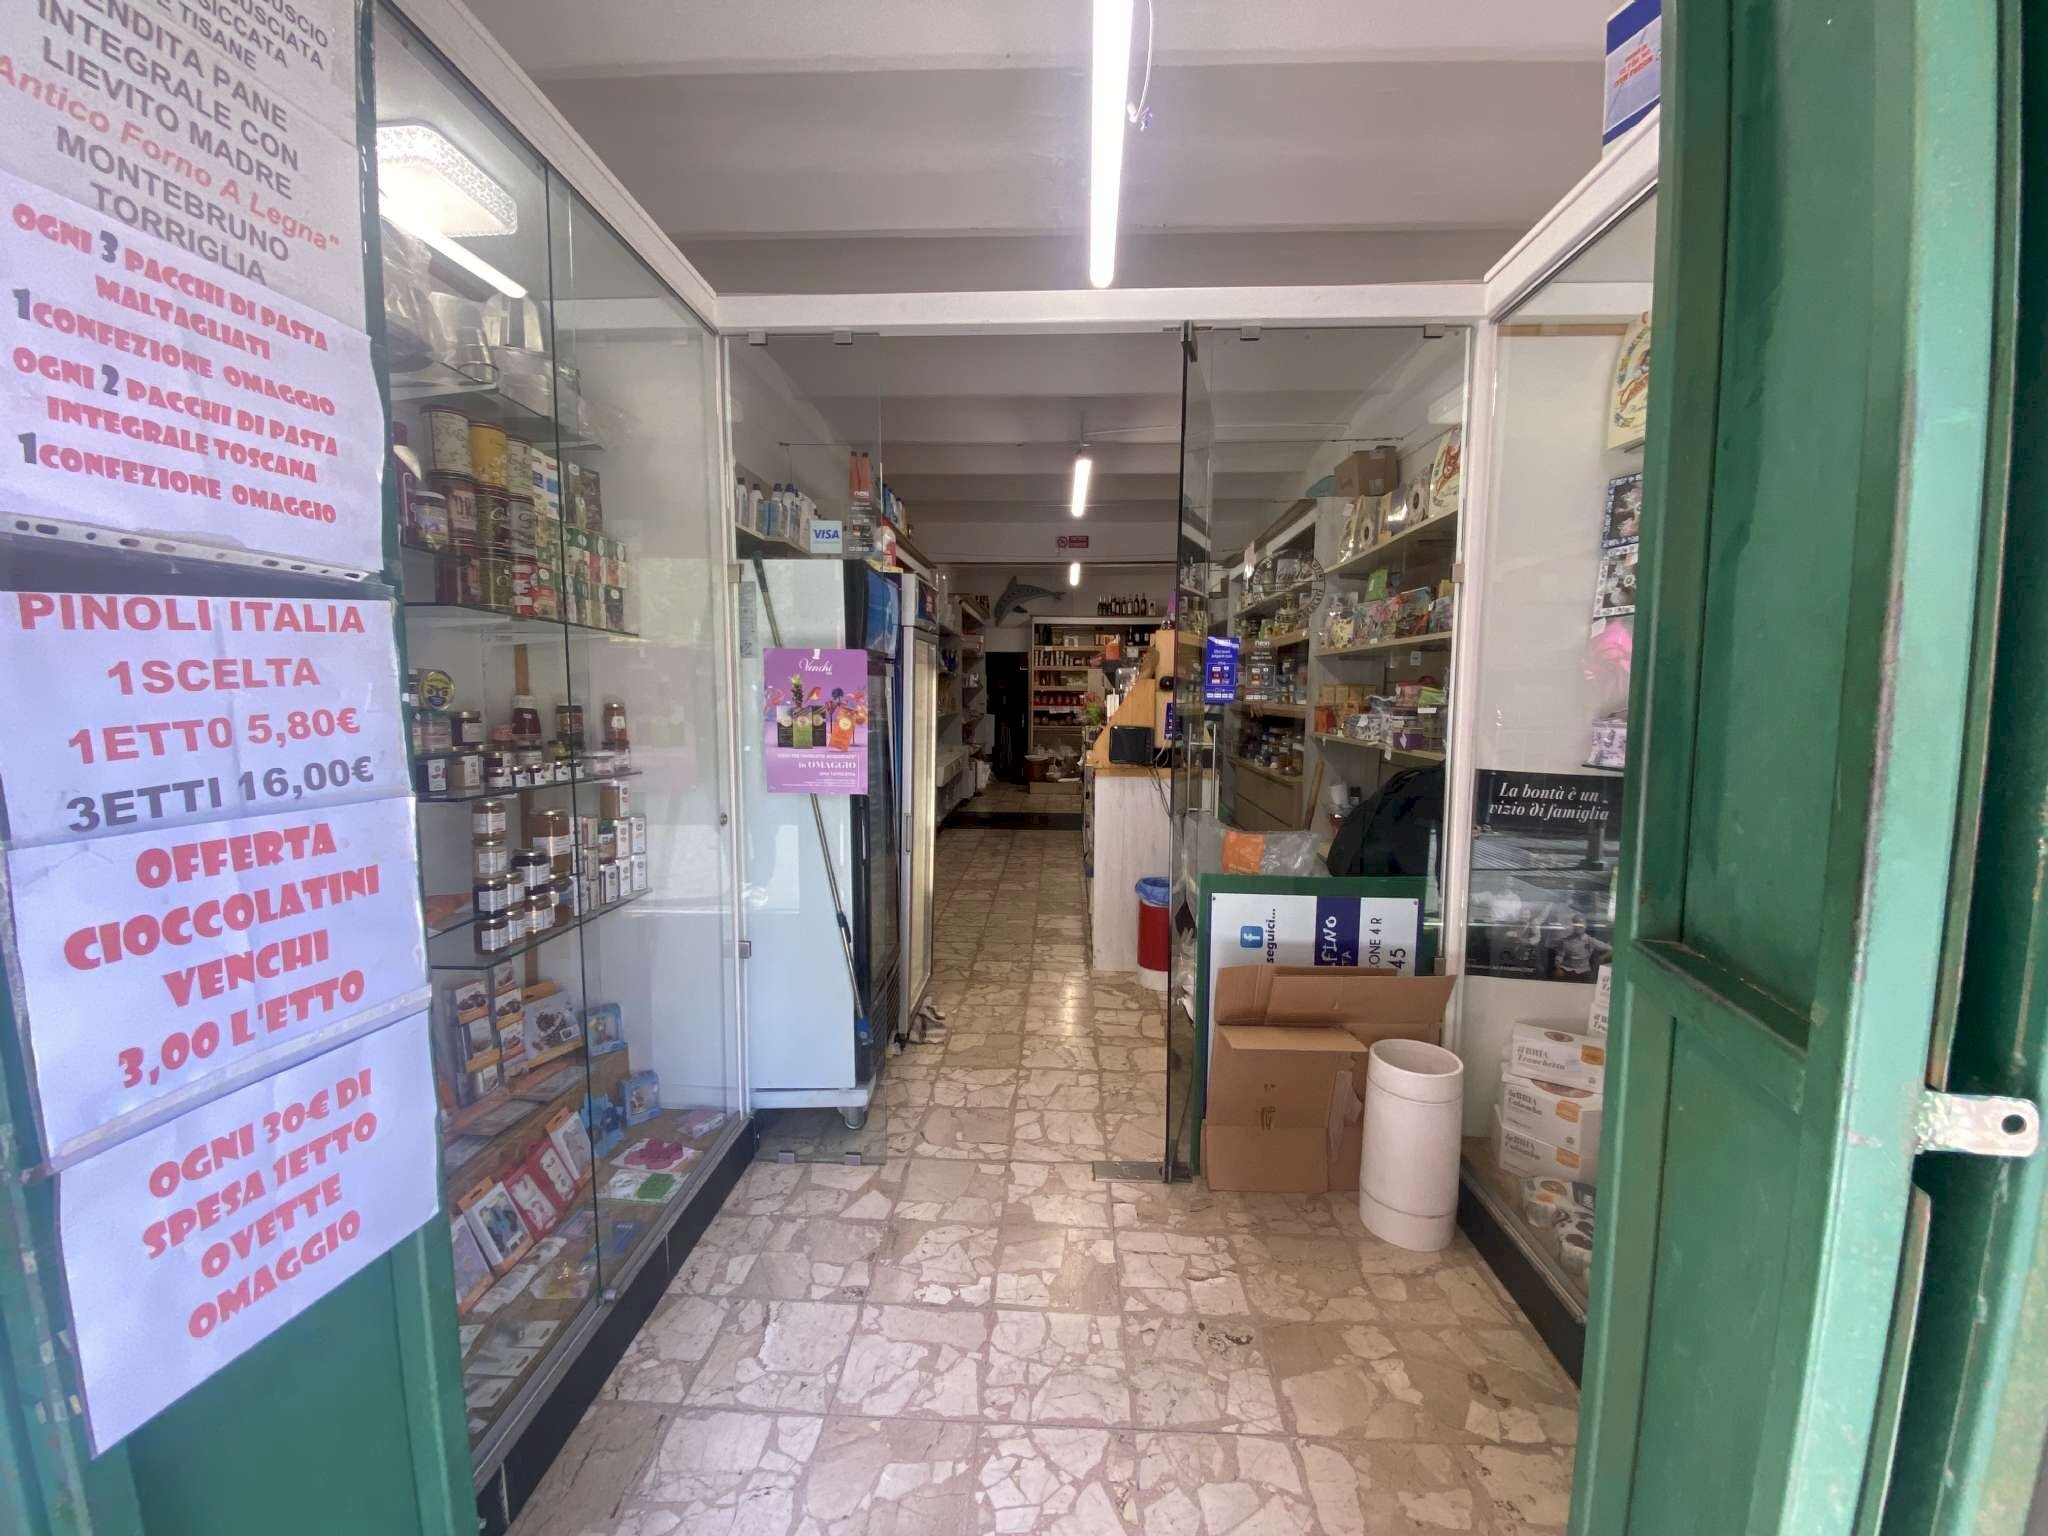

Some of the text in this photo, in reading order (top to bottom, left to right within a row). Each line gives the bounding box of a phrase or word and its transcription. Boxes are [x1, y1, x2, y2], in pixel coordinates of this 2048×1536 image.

[178, 2, 257, 71] TISANE
[38, 0, 300, 172] INTEGRALE CON
[42, 36, 293, 200] LIEVITO MADRE
[212, 63, 289, 133] PANE
[0, 54, 110, 134] Antico
[120, 121, 212, 189] Forno
[219, 178, 241, 206] A
[56, 125, 290, 263] MONTEBRUNO
[90, 181, 268, 286] TORRIGLIA
[12, 203, 329, 352] OGNI 3 PACCHI DI PASTA
[95, 274, 271, 361] MALTAGLIATI
[12, 347, 338, 457] OGNI 2 PACCHI DI PASTA
[222, 365, 336, 417] OMAGGIO
[47, 396, 318, 483] INTEGRALE TOSCANA
[232, 484, 337, 524] OMAGGIO
[814, 528, 840, 540] VISA
[17, 593, 366, 634] PINOLI ITALIA
[247, 707, 362, 749] 5,80€
[808, 761, 857, 769] OMAGGIO
[237, 756, 374, 802] 16,00€
[1498, 782, 1518, 797] La
[1522, 783, 1565, 800] bontà
[1579, 791, 1600, 802] un
[1529, 803, 1545, 817] di
[1544, 804, 1610, 823] famiglia
[135, 823, 338, 889] OFFERTA
[63, 864, 381, 971] CIOCCOLATINI
[1369, 939, 1381, 969] ONE
[1370, 917, 1383, 925] R
[161, 928, 330, 1009] VENCHI
[117, 969, 366, 1089] 3,00 L'ETTO
[148, 1068, 373, 1198] OGNI 30€ DI
[142, 1169, 267, 1260] SPESA
[200, 1172, 344, 1279] OVETTE
[187, 1209, 362, 1339] OMAGGIO
